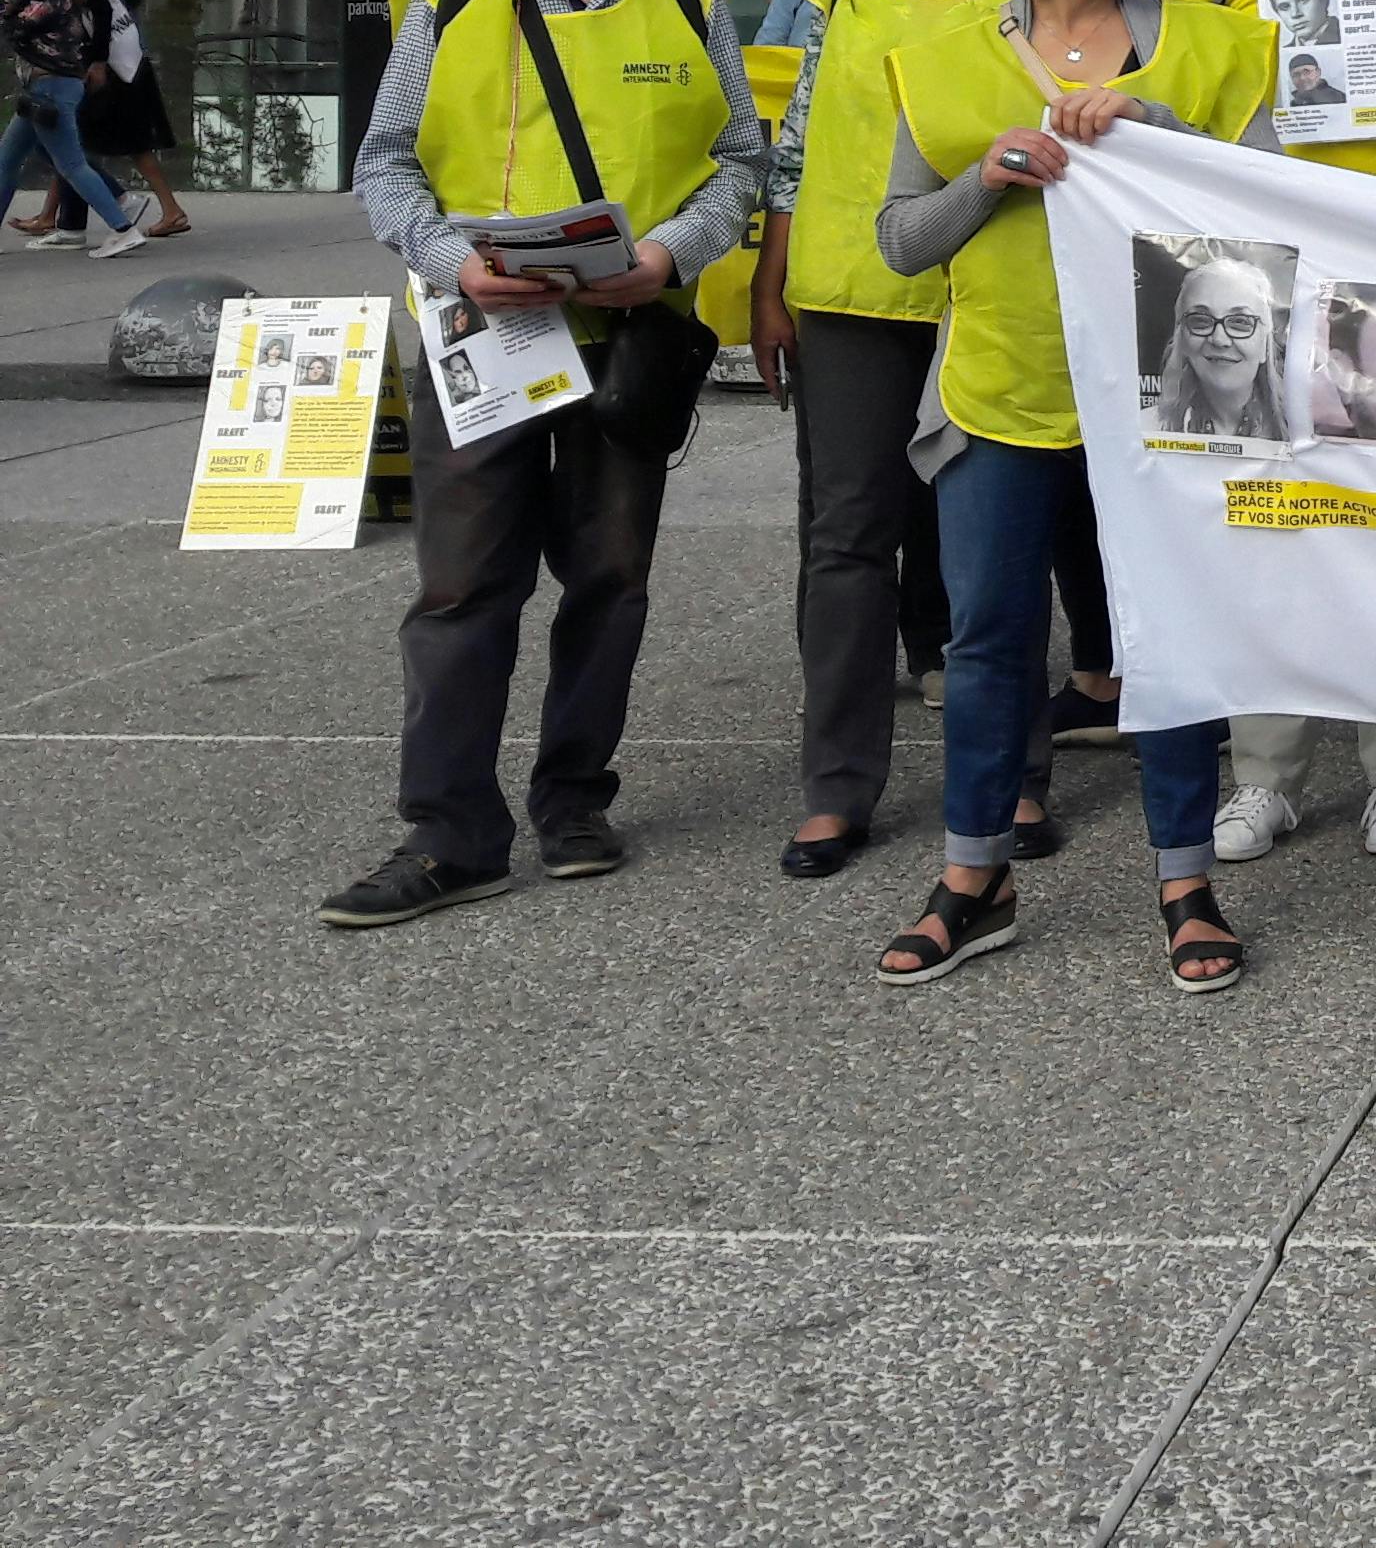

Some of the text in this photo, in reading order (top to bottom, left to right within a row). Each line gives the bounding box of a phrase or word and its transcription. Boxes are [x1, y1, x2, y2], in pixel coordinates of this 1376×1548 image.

[623, 63, 671, 75] AMNESTY
[1209, 442, 1243, 455] TURQUIE
[210, 456, 249, 467] AMNESTY
[1227, 494, 1274, 509] GRÂCE
[1288, 498, 1339, 510] NOTRE
[1228, 510, 1368, 527] ET VOS SIGNATURES
